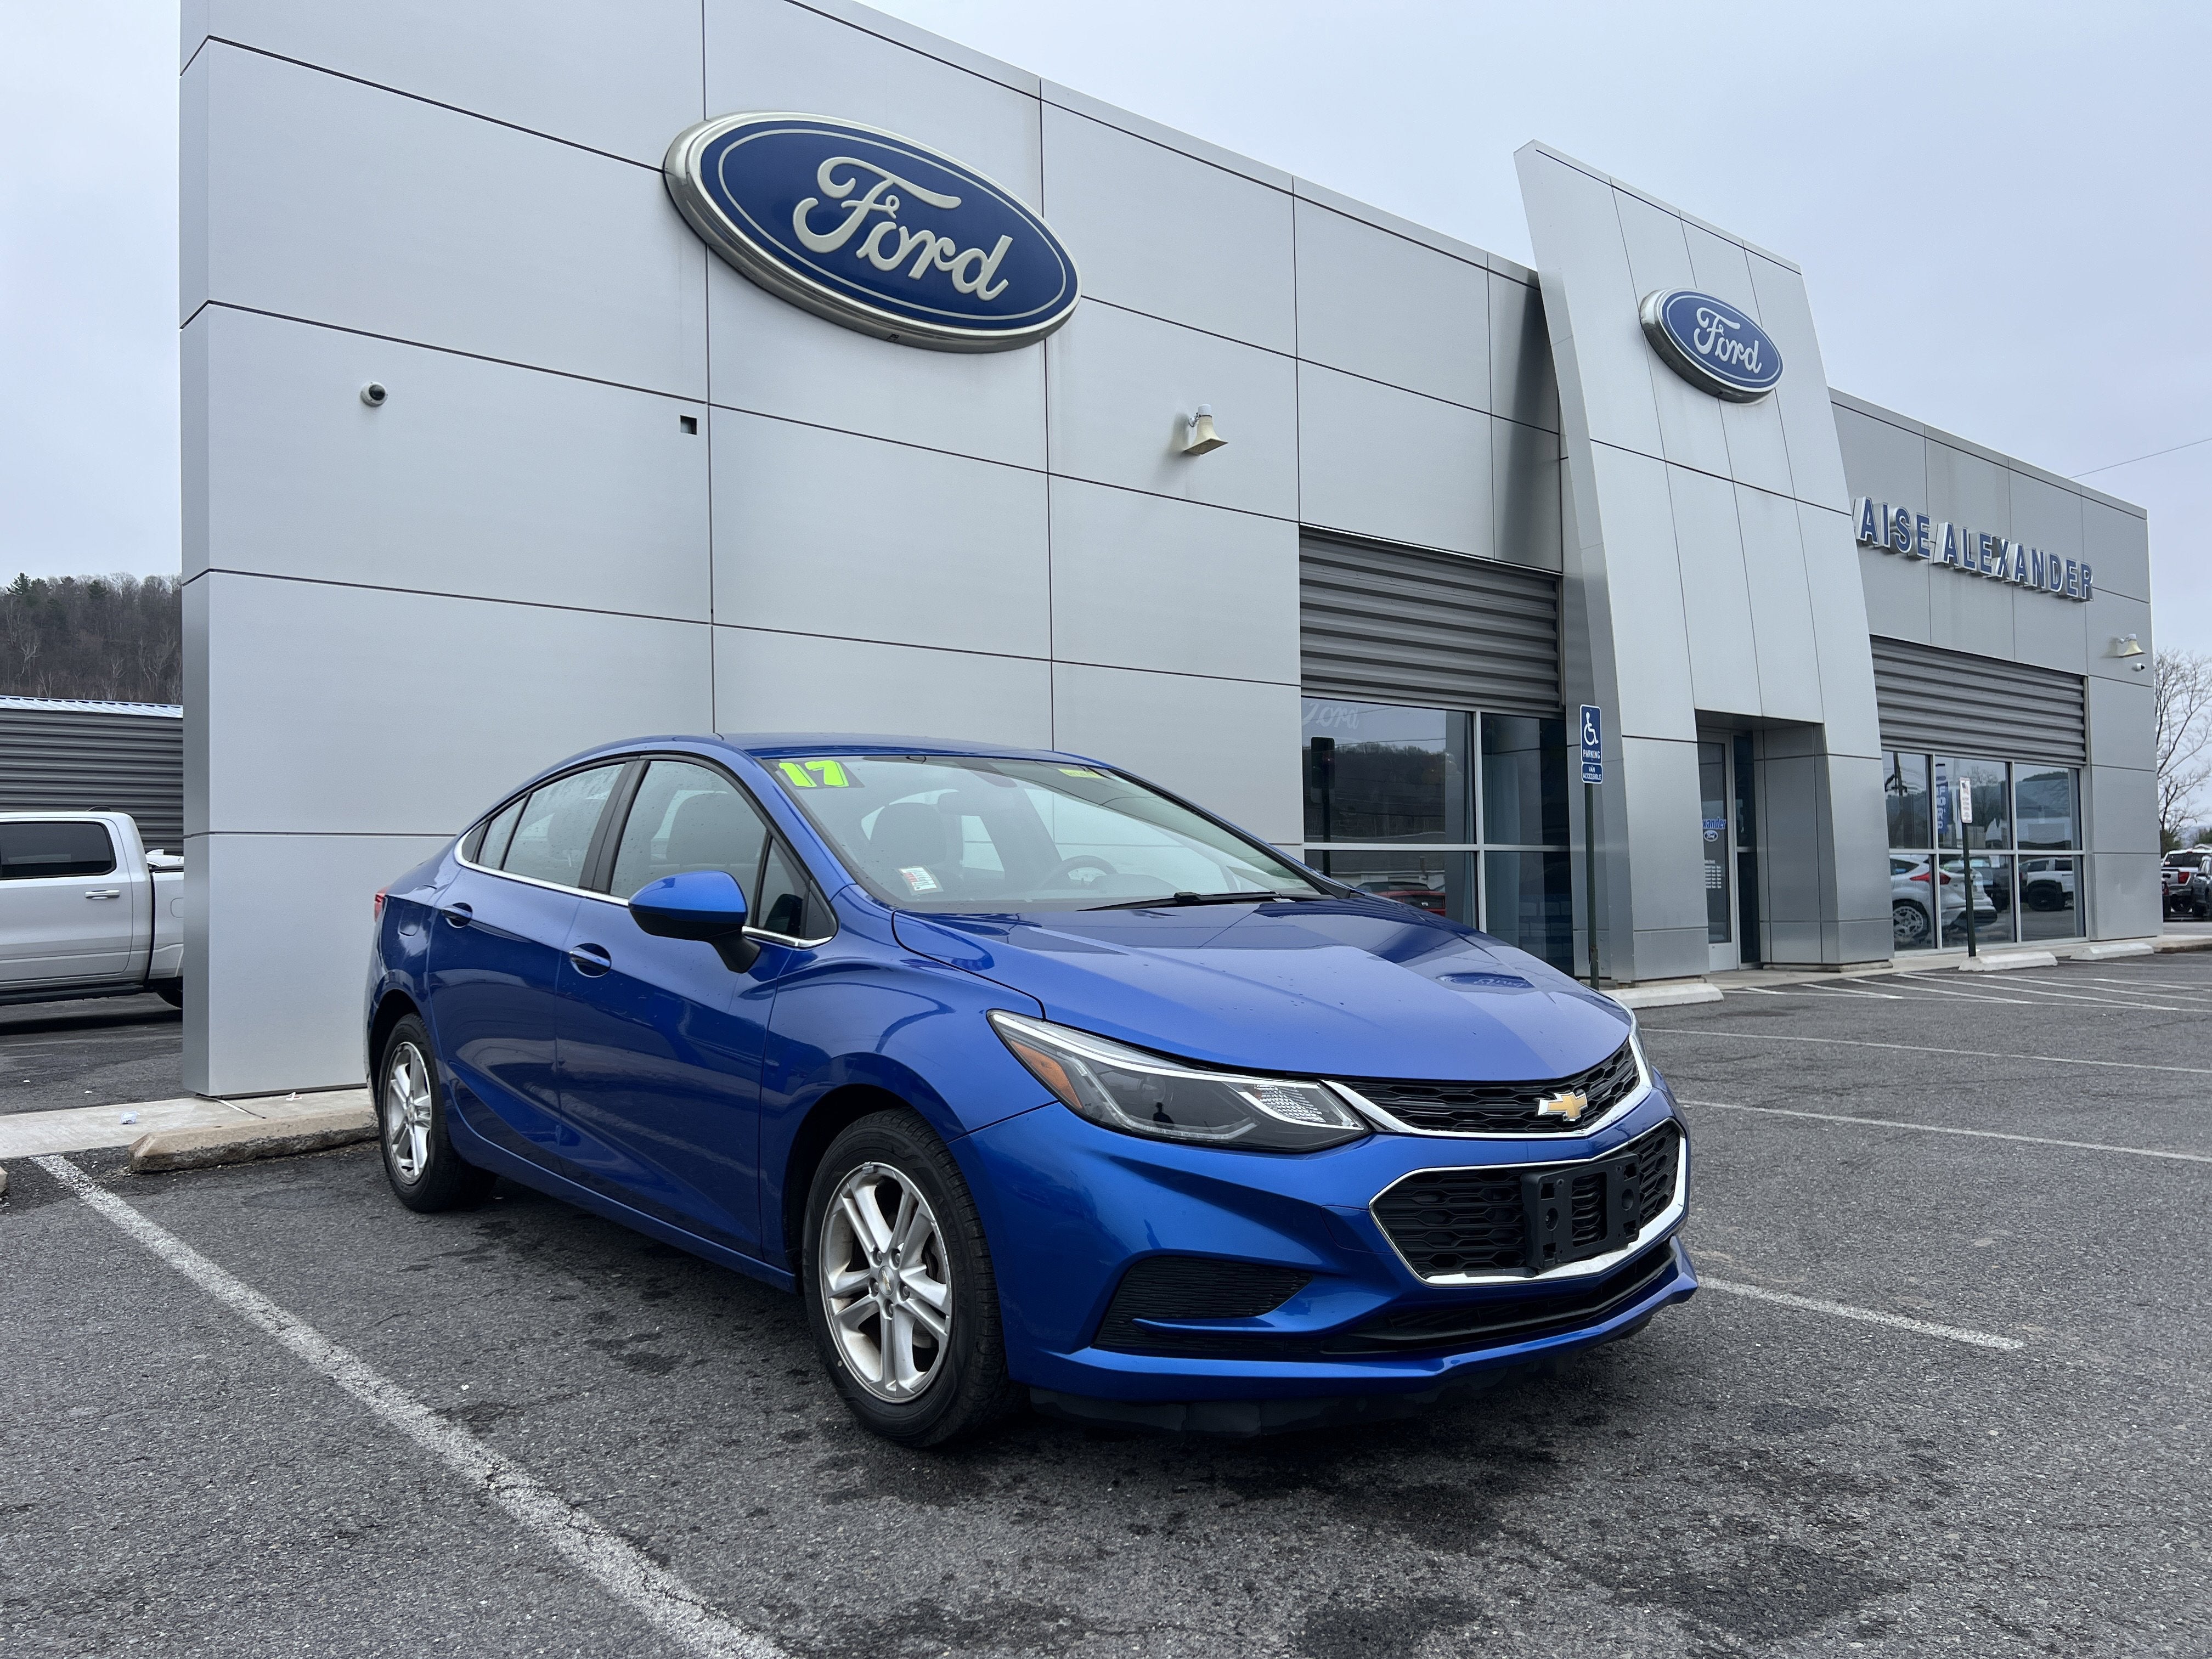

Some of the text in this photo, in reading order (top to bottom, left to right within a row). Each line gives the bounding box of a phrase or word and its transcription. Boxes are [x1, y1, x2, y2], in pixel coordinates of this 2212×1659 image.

[793, 156, 1014, 301] Ford
[1694, 307, 1762, 374] Ford
[1857, 496, 2094, 601] AISE ALEXANDER
[778, 760, 849, 787] 17
[1583, 749, 1600, 759] PARKING
